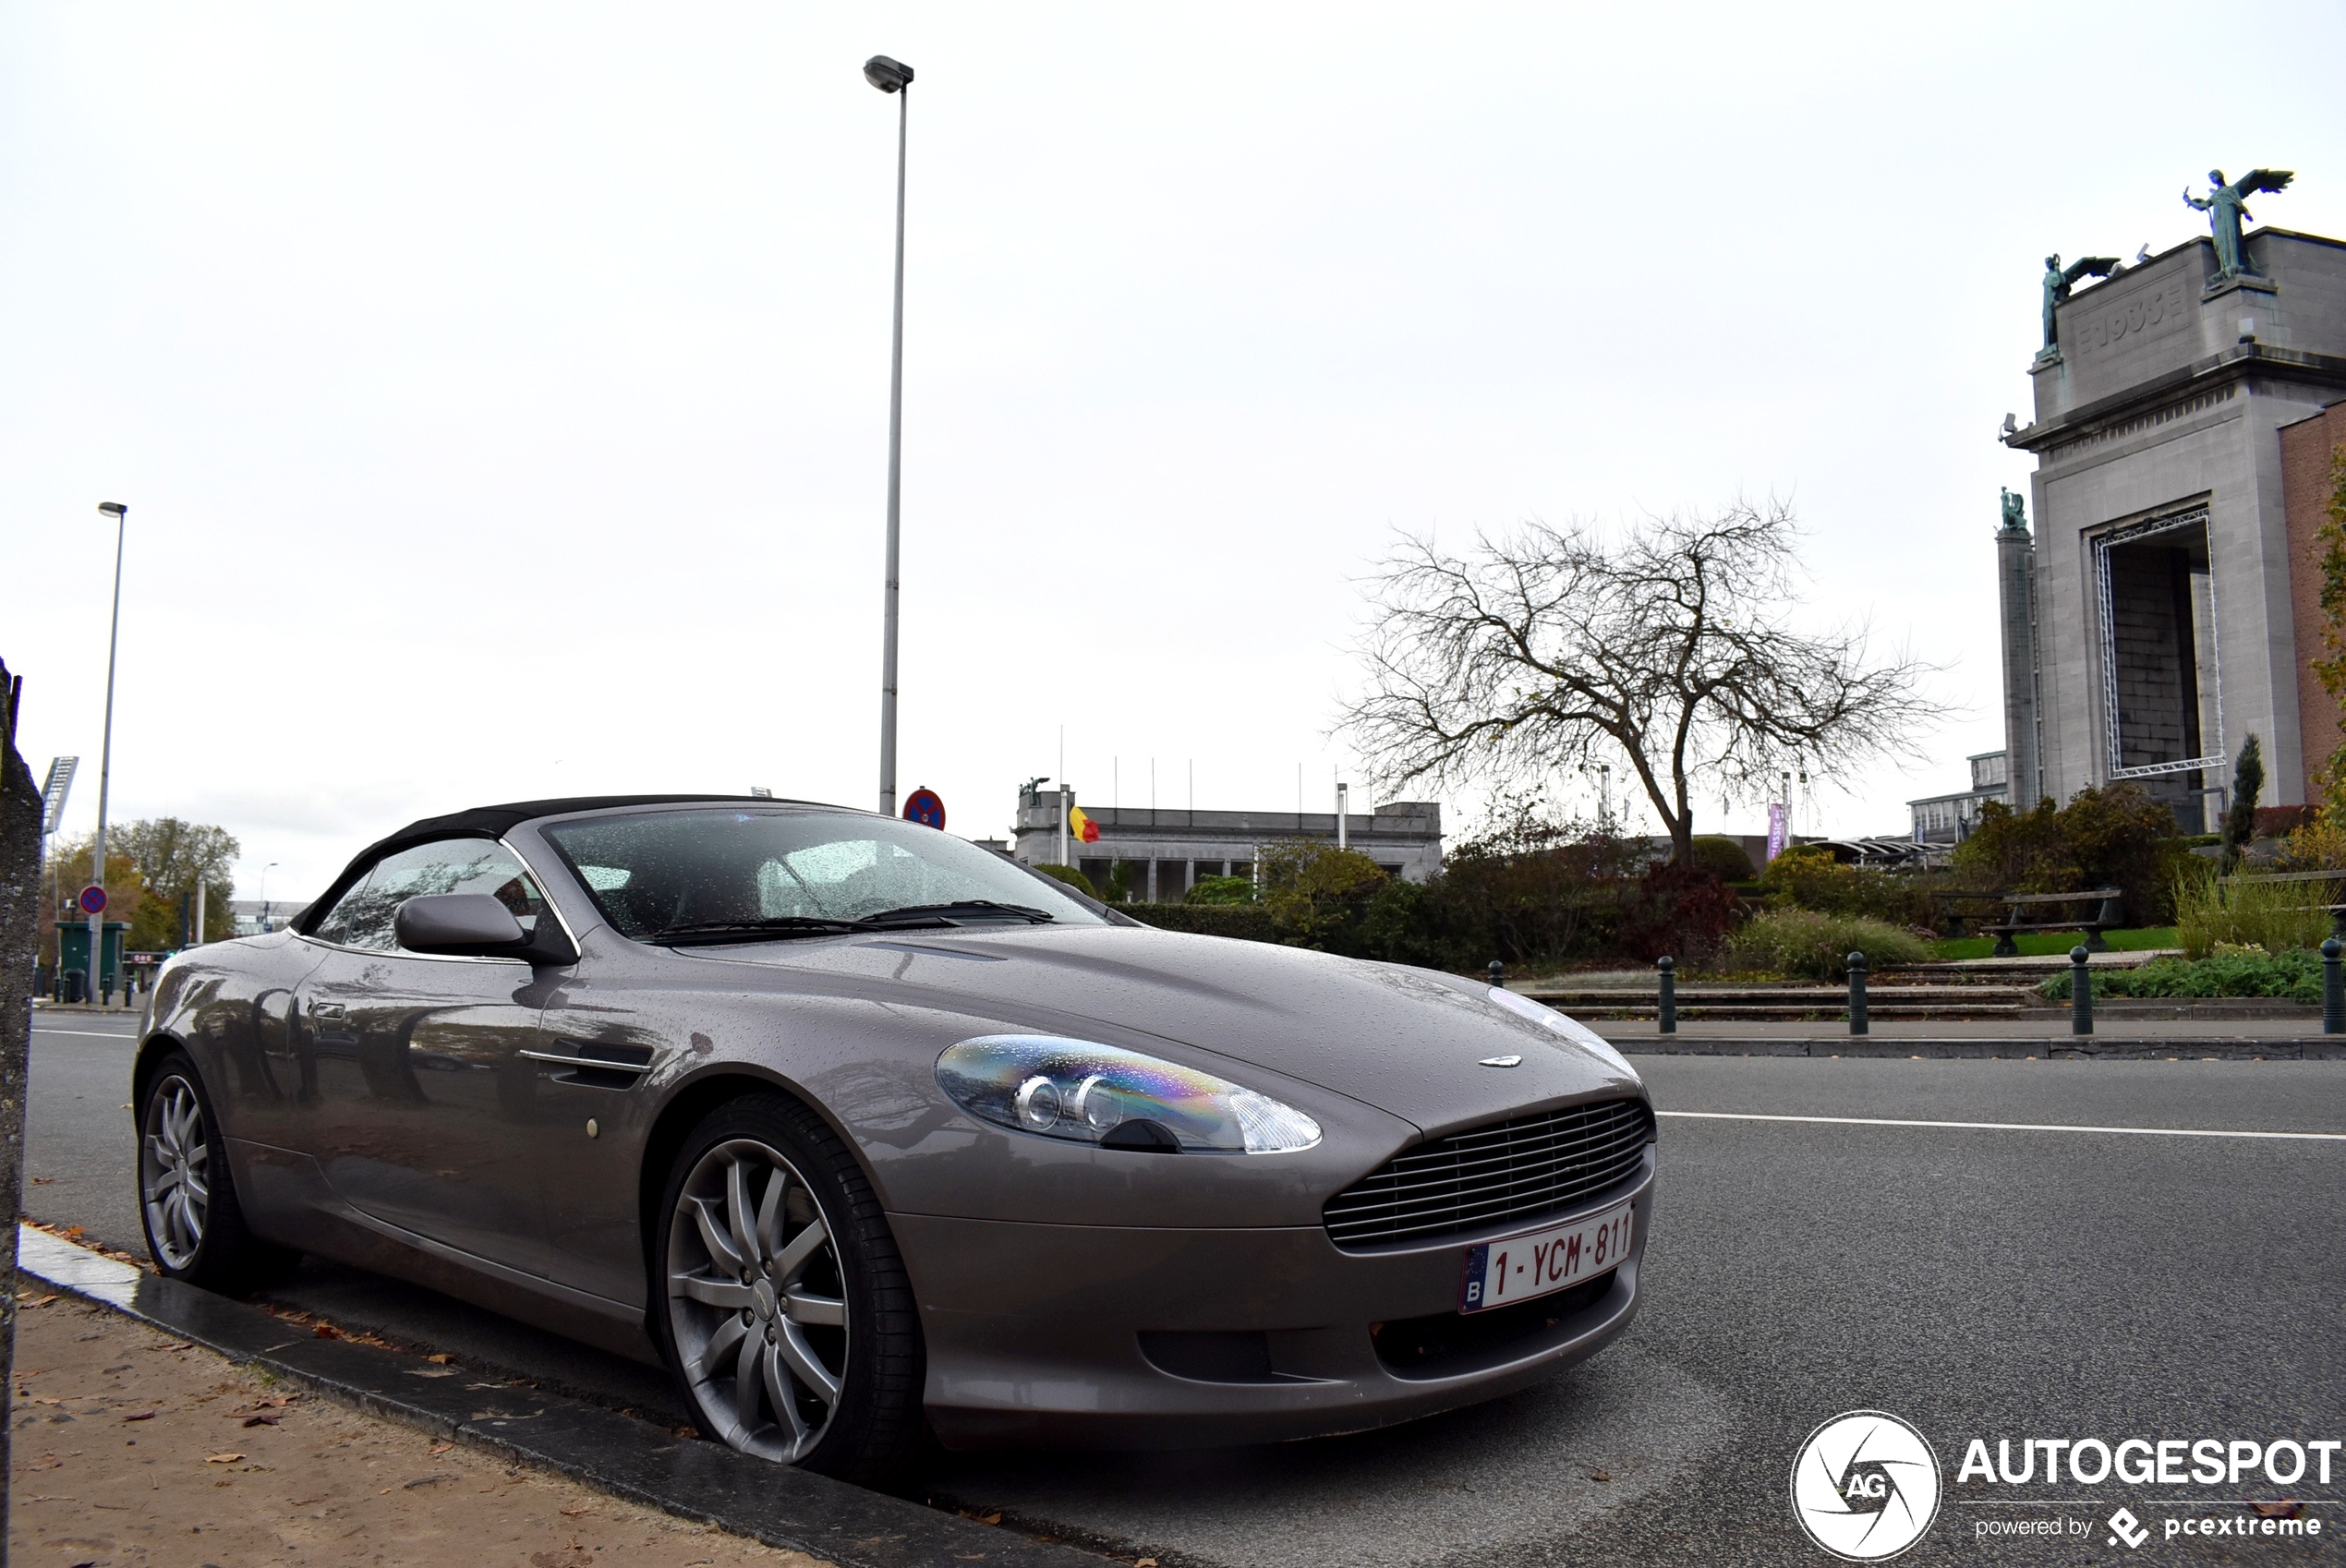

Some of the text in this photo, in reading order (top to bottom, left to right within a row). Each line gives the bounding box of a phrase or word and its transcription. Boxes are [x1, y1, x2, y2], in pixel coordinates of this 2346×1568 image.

[2094, 292, 2164, 348] 1935
[1495, 1212, 1629, 1296] 1-YCM-811
[1467, 1281, 1481, 1302] B
